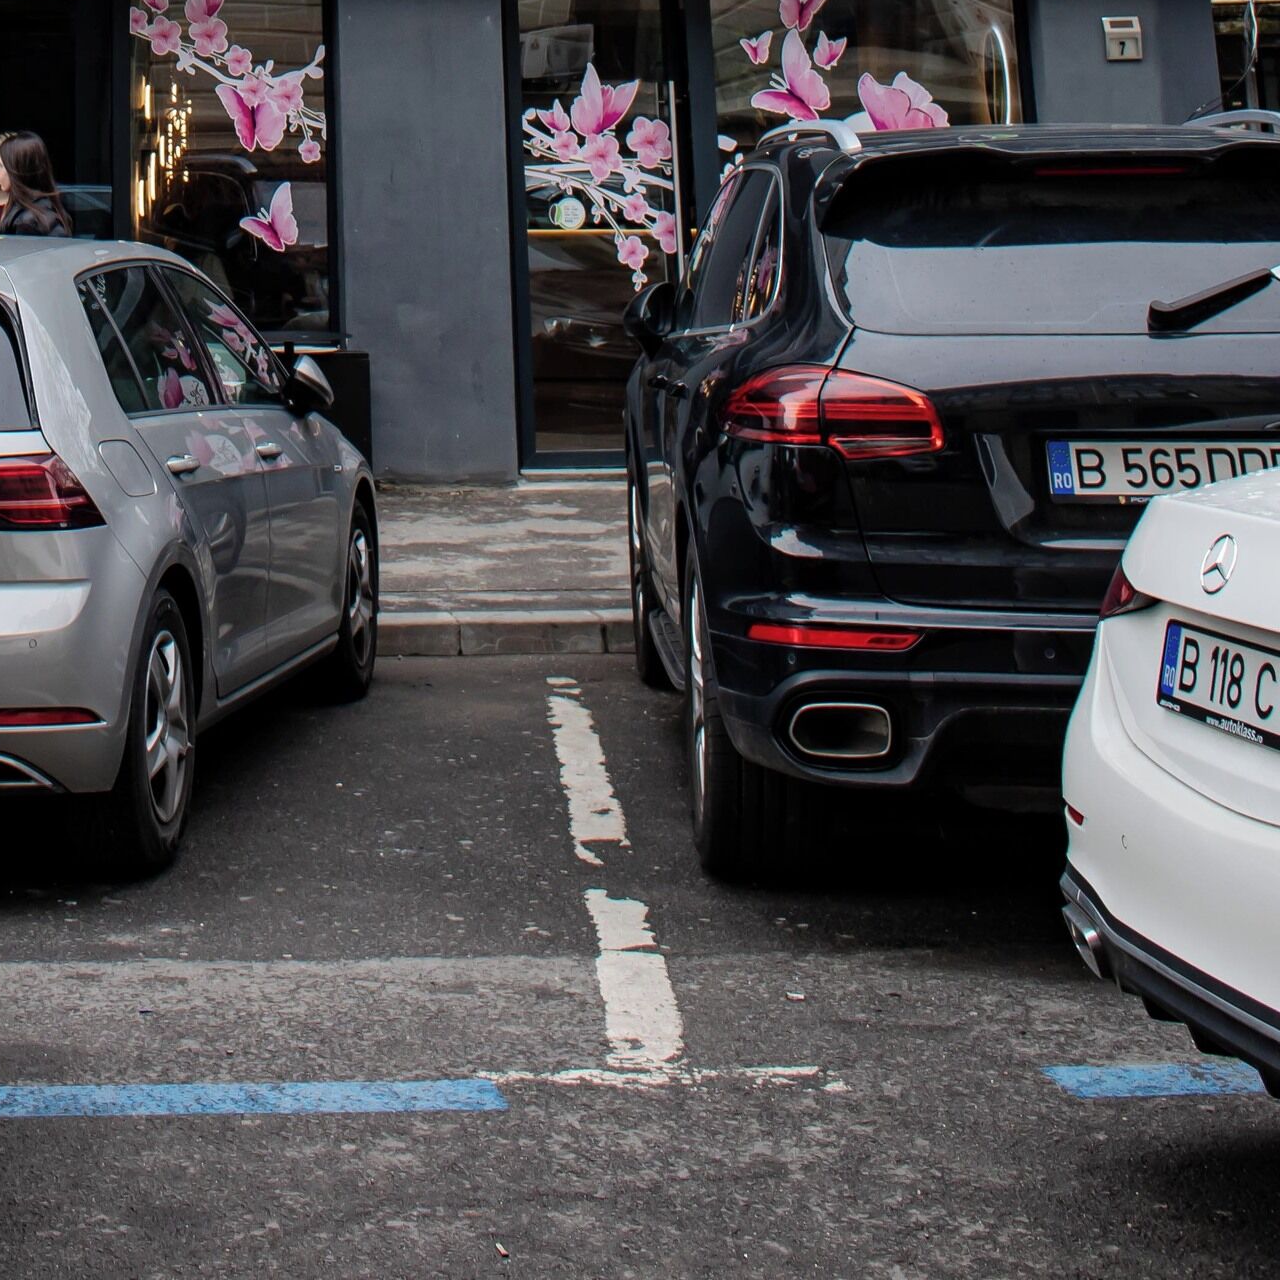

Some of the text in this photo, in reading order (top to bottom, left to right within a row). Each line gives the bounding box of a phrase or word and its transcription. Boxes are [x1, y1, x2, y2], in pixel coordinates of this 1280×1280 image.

[1119, 40, 1126, 56] 7
[1075, 448, 1106, 489] B
[1054, 473, 1073, 489] RO
[1163, 664, 1176, 688] RO
[1178, 636, 1277, 720] B 118 C
